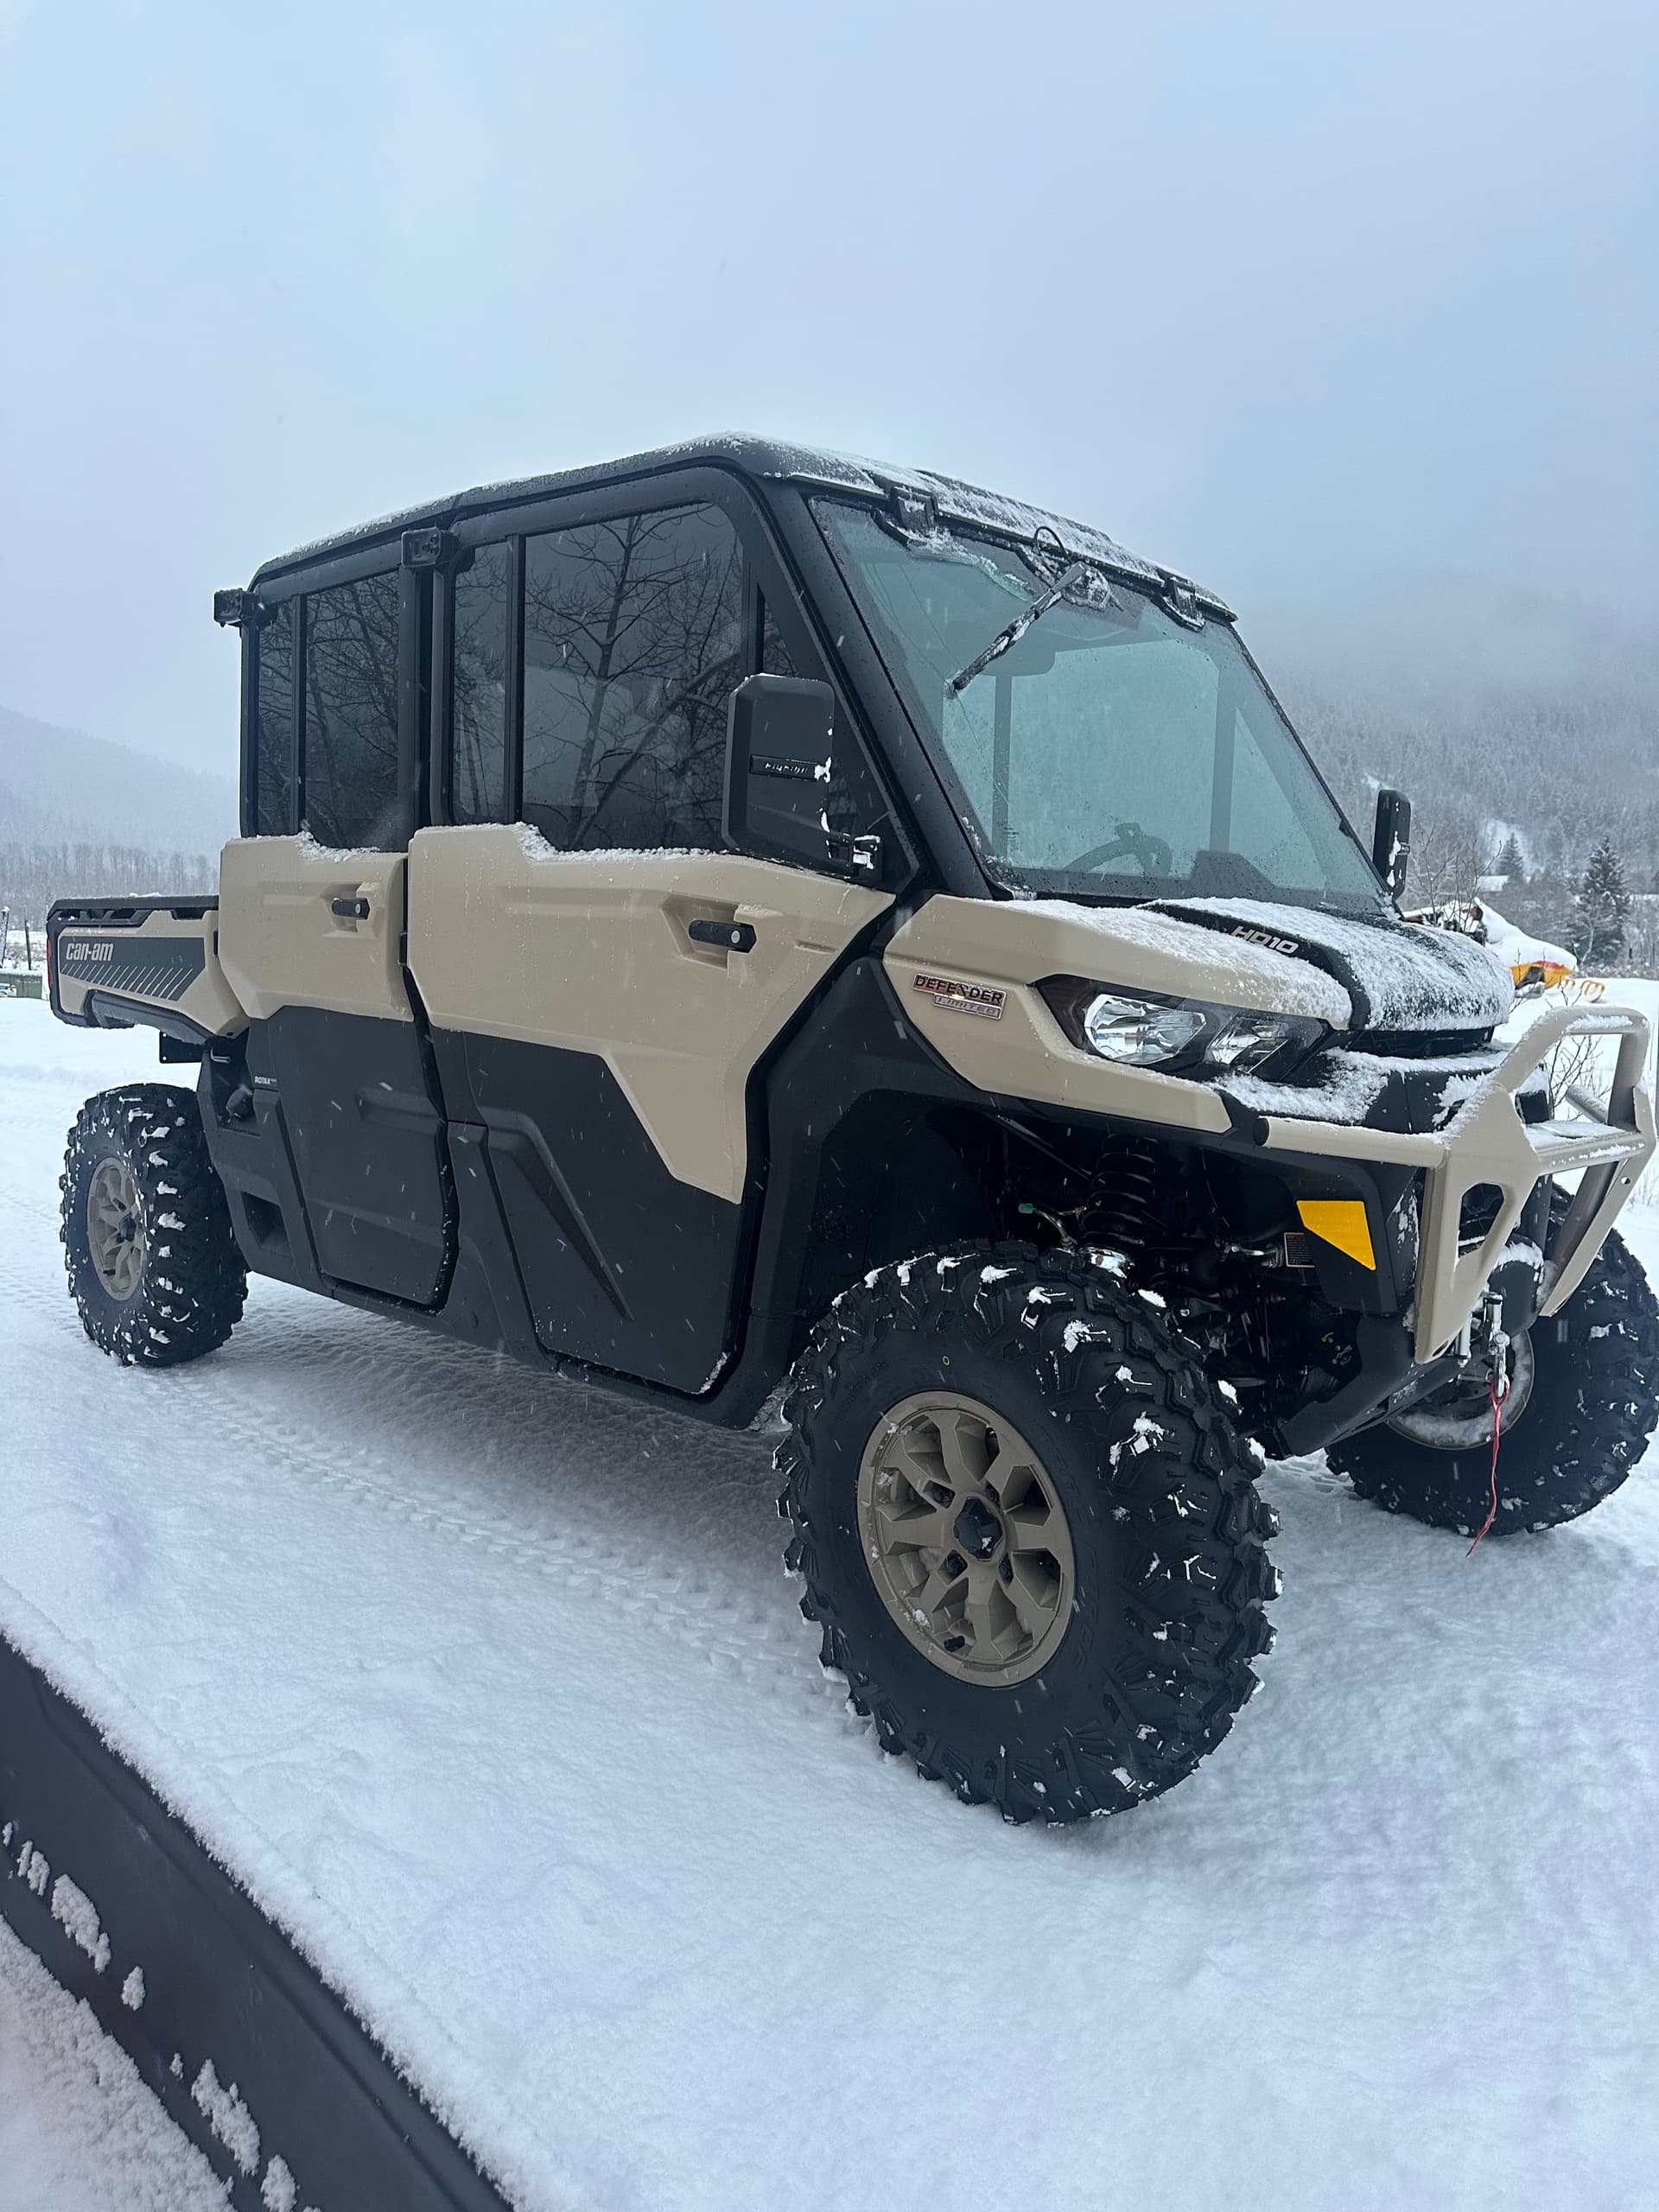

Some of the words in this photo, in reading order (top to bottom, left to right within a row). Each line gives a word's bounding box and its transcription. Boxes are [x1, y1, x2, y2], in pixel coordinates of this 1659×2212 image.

[66, 943, 114, 962] can-am
[1230, 925, 1300, 954] HD10
[915, 974, 1004, 1005] DEFENDER
